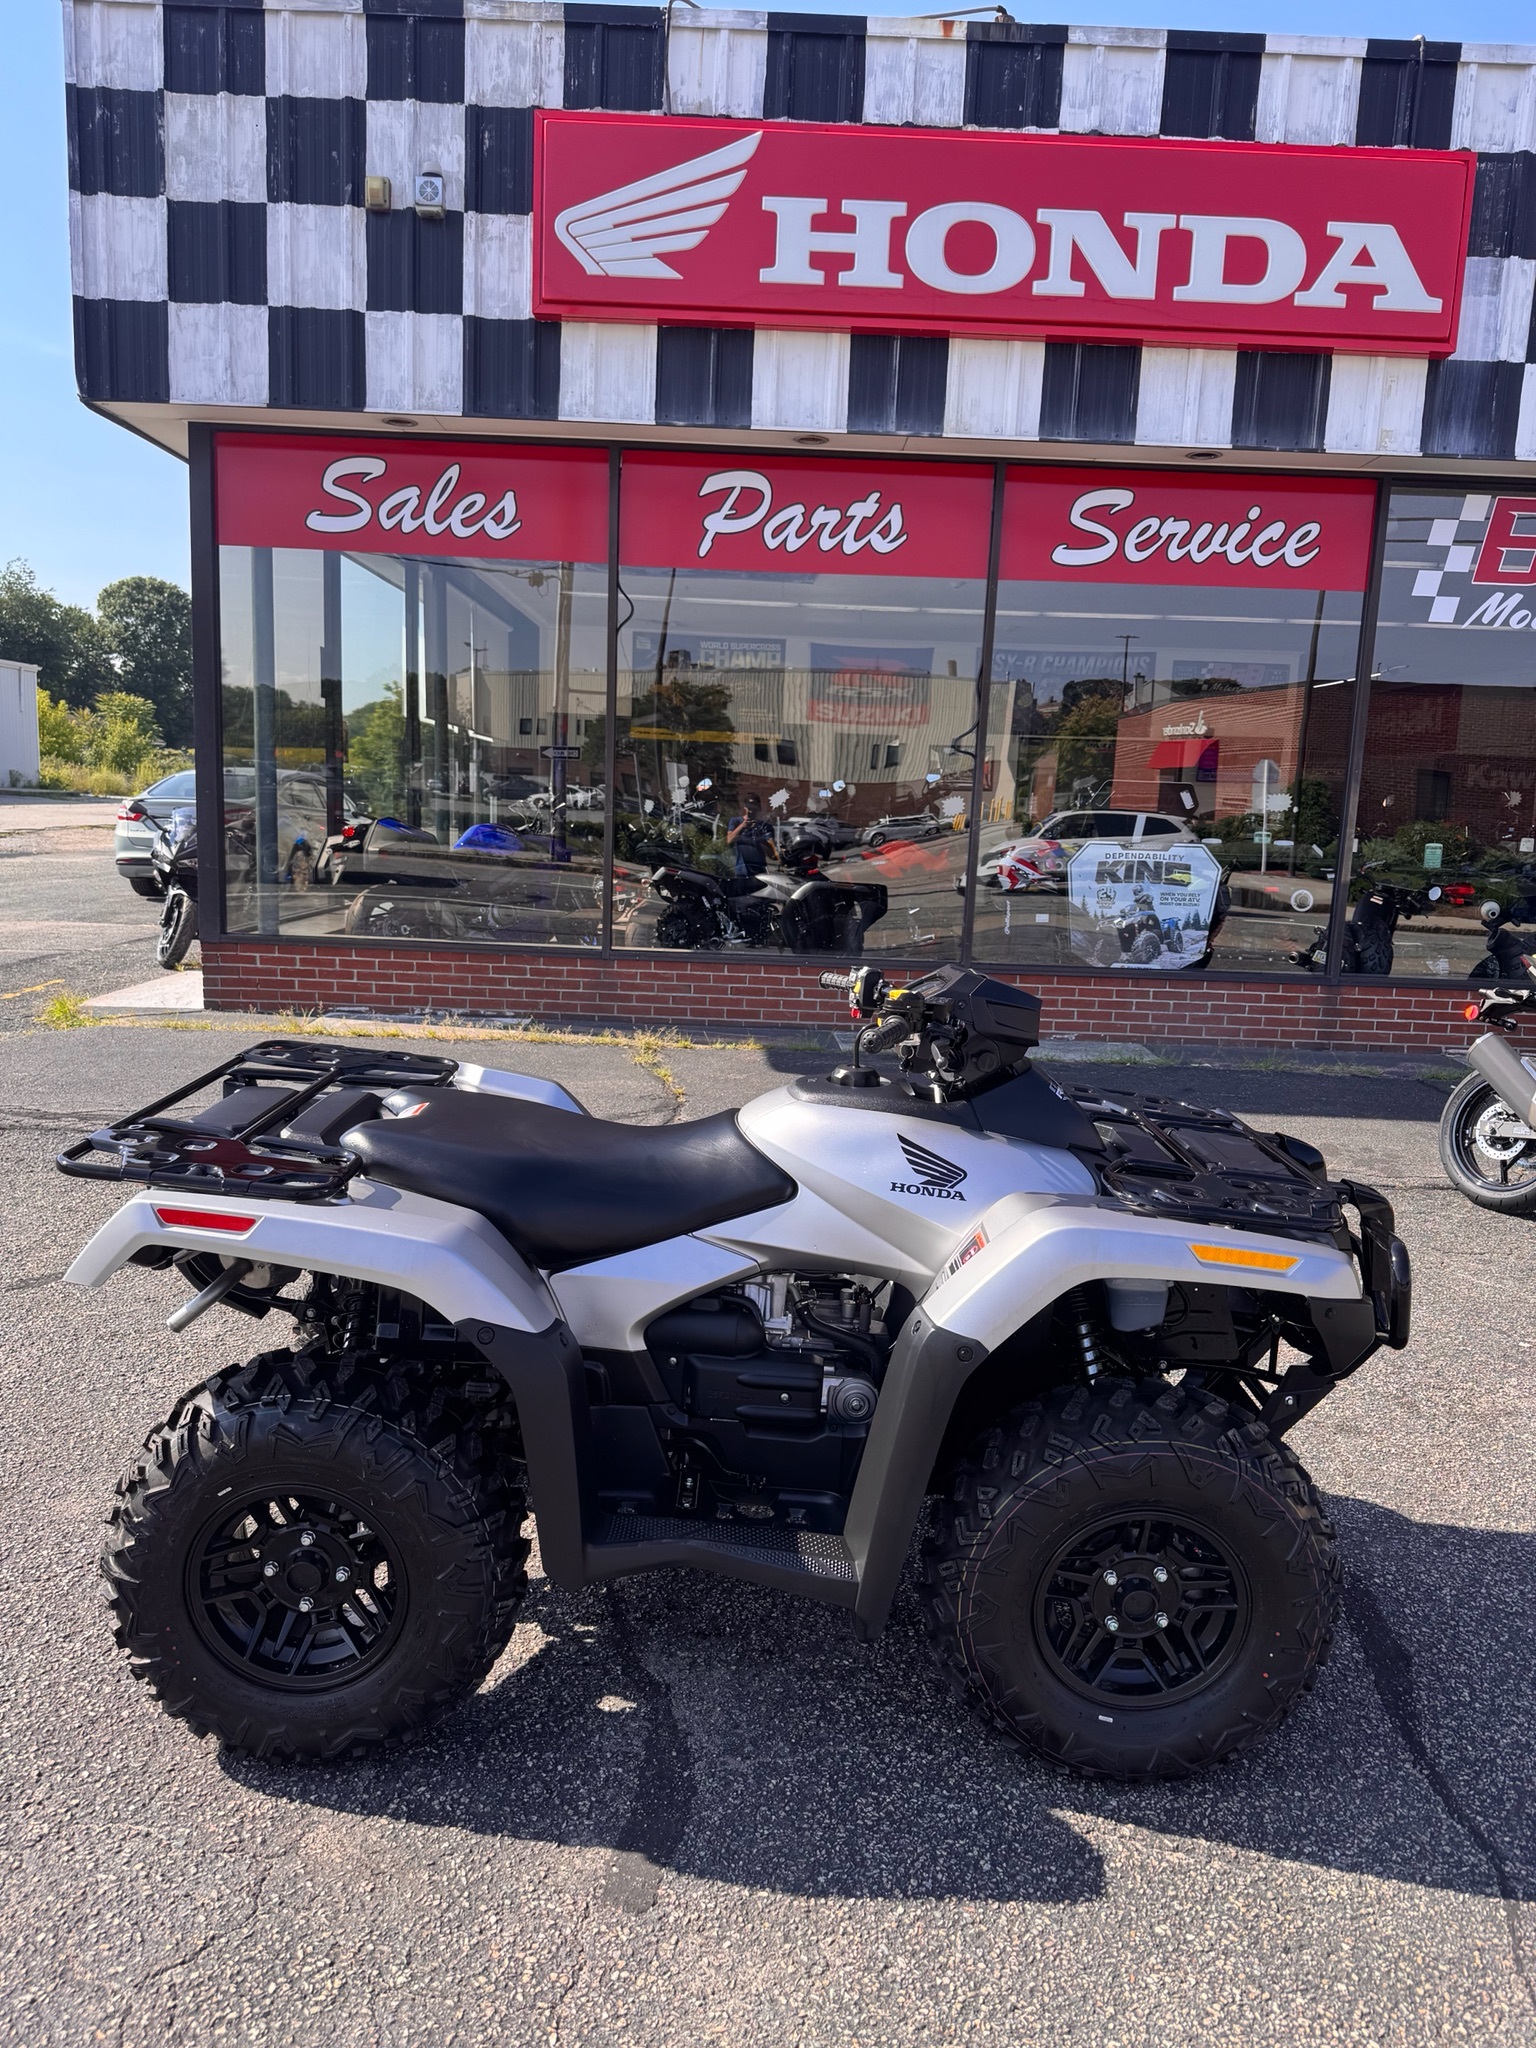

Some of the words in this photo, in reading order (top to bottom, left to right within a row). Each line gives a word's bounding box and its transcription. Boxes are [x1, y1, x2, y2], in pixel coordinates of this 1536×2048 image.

[759, 196, 1443, 314] HONDA
[305, 455, 522, 540] Sales
[697, 469, 909, 558] Parts
[1050, 487, 1322, 568] Service
[1461, 591, 1536, 629] Mo
[700, 641, 729, 650] WORLD
[730, 642, 782, 651] SUPERCROSS
[1040, 654, 1151, 676] CHAMPIONS
[1105, 852, 1185, 861] DEPENDABILITY
[889, 1181, 967, 1201] HONDA
